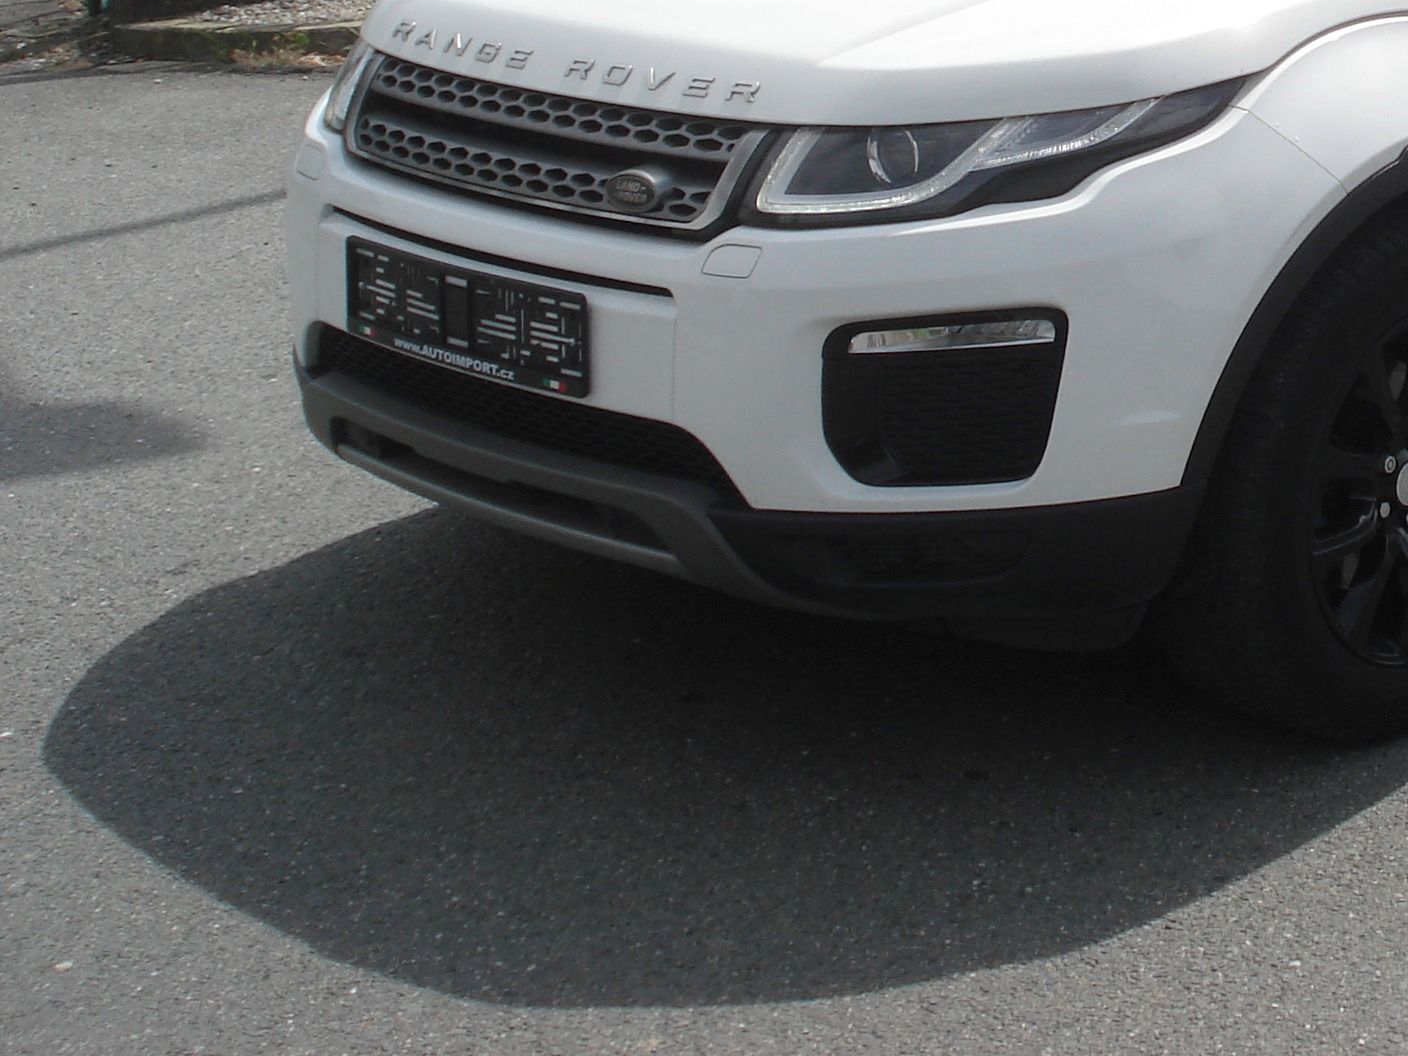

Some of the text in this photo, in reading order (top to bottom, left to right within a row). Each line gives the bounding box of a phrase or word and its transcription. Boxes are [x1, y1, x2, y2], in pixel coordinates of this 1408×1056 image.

[391, 19, 761, 103] RANGE ROVER
[394, 337, 515, 381] www.AUTOIMPORT.cz
